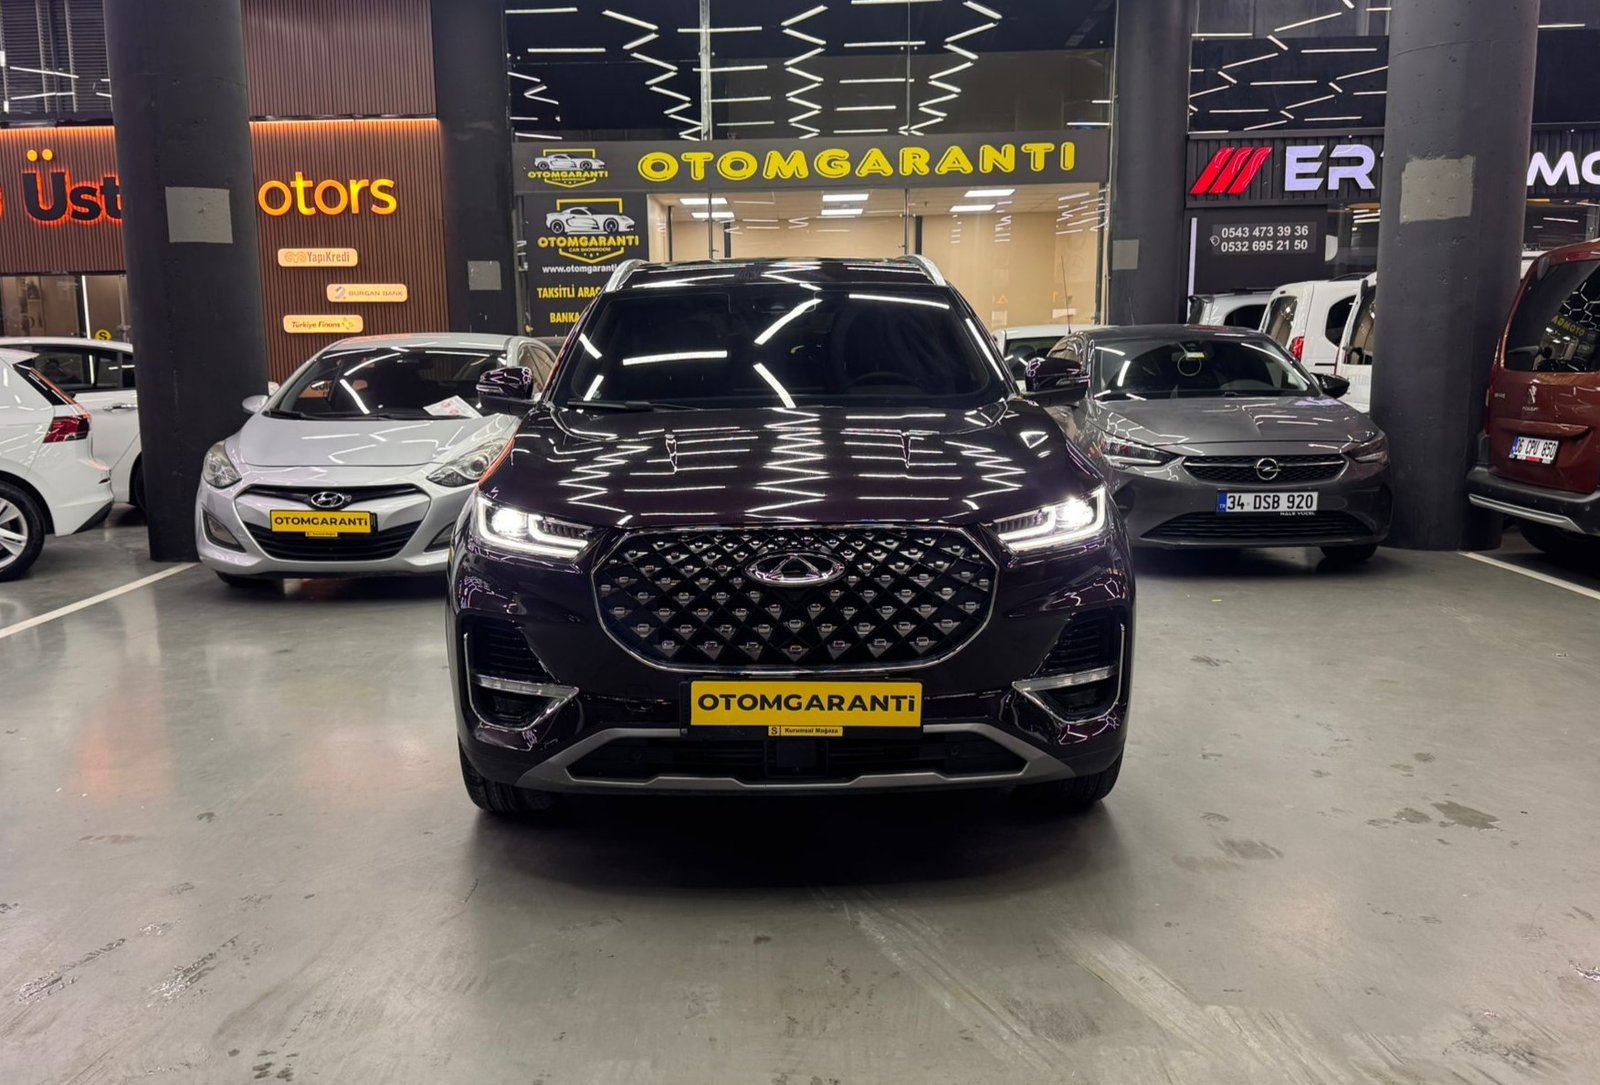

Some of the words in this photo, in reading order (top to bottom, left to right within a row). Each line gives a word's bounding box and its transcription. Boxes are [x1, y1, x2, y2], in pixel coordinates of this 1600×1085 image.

[637, 141, 1076, 182] OTOMGARANTI
[1284, 144, 1384, 191] ER
[527, 170, 609, 179] OTOMGARANTI
[1221, 227, 1249, 238] 0543
[1252, 226, 1274, 237] 473
[1277, 225, 1291, 236] 39
[1294, 225, 1309, 236] 36
[537, 235, 639, 248] OTOMGARANTI
[1220, 241, 1249, 252] 0532
[1252, 240, 1274, 251] 695
[1276, 240, 1290, 251] 21
[1293, 239, 1308, 250] 50
[537, 284, 575, 299] TAKSİTLİ
[549, 312, 581, 323] BANKA
[1525, 440, 1539, 455] CPU
[1541, 442, 1557, 457] 850
[1227, 495, 1245, 510] 34
[1253, 494, 1280, 510] DSB
[1287, 494, 1313, 509] 920
